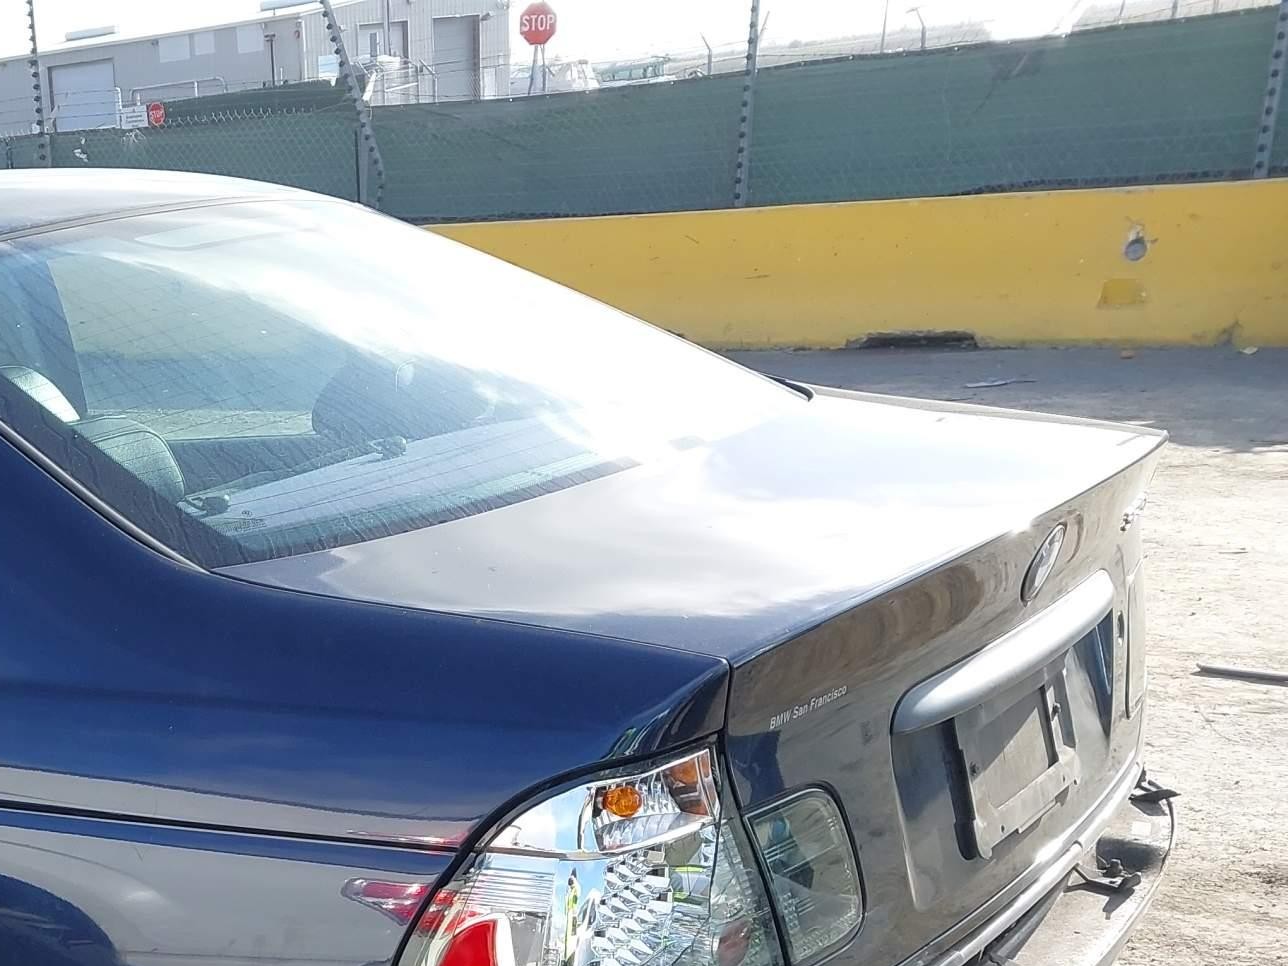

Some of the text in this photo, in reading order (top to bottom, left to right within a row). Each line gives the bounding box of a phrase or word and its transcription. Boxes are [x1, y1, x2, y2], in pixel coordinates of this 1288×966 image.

[522, 14, 554, 32] STOP
[769, 685, 848, 730] BMW San Francisco
